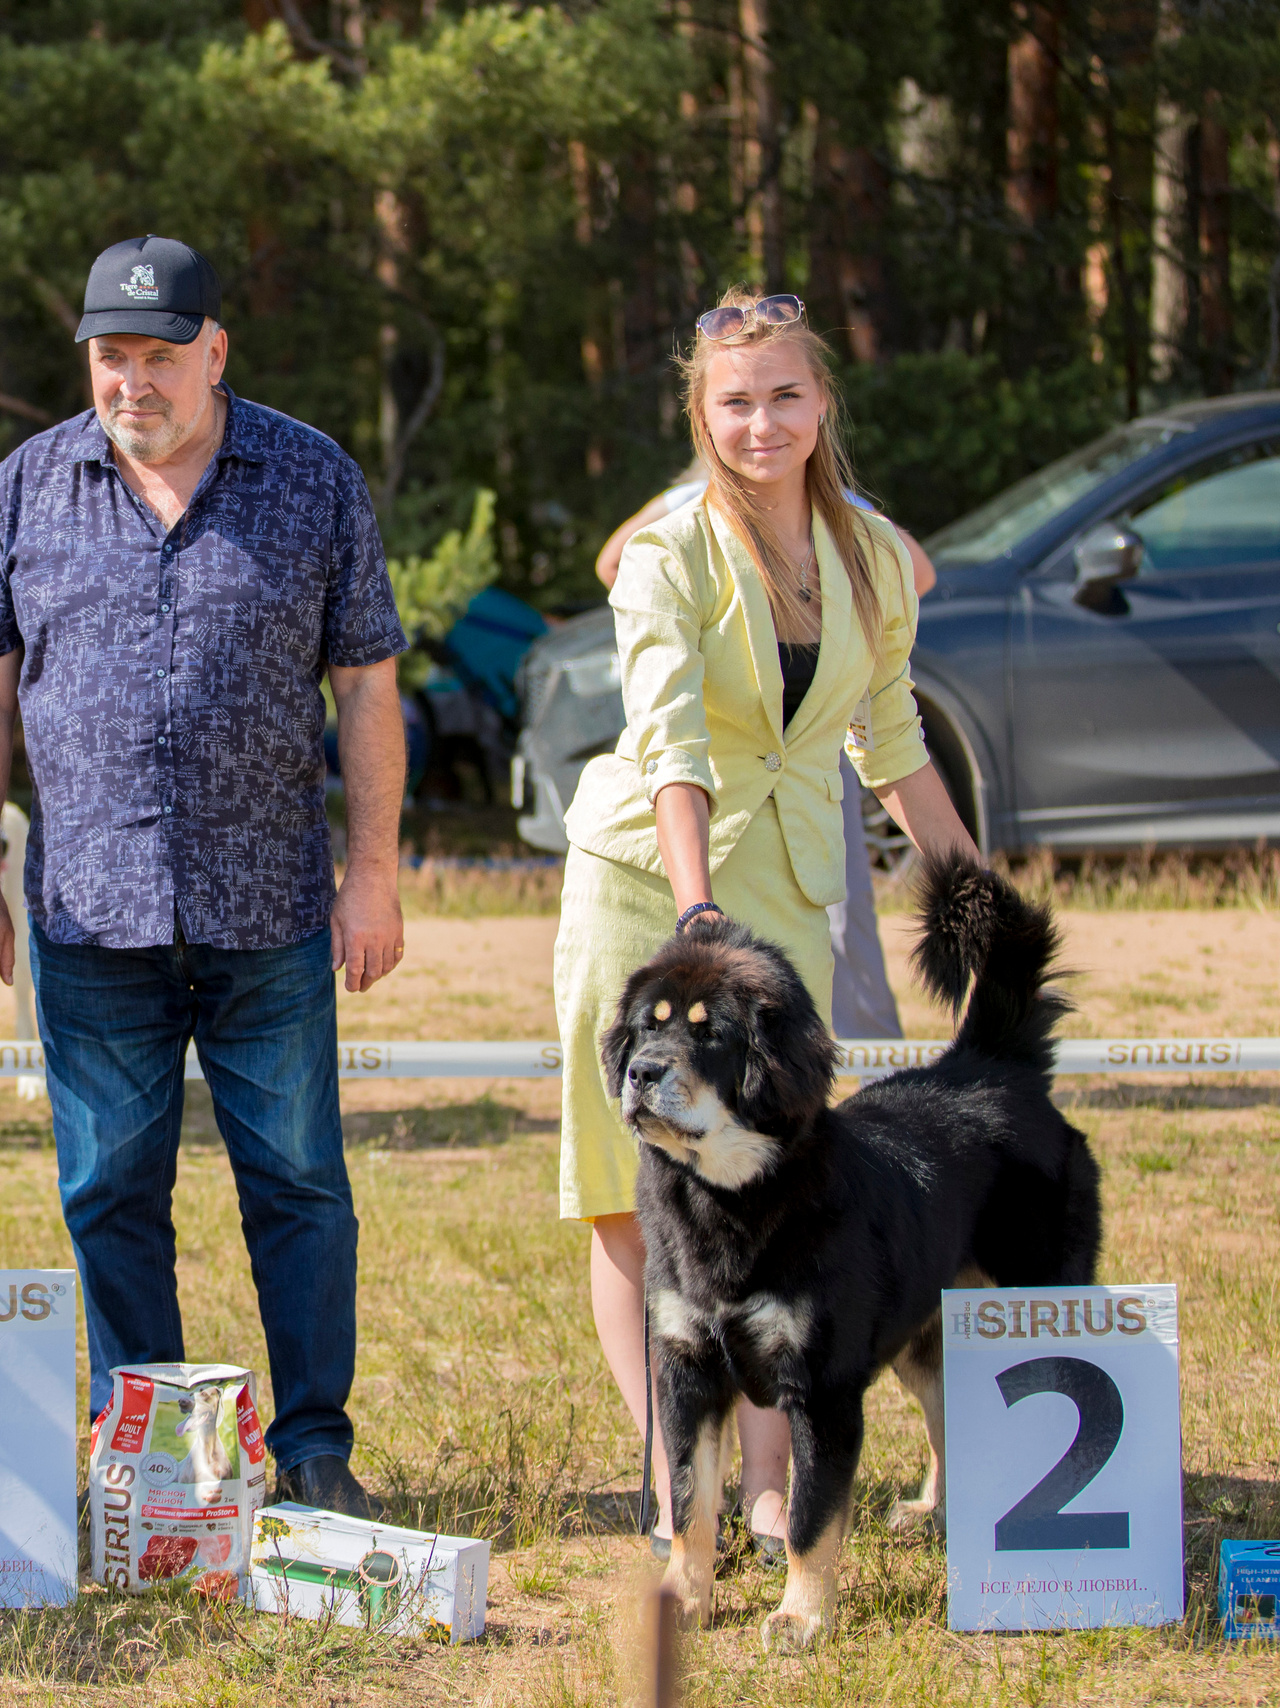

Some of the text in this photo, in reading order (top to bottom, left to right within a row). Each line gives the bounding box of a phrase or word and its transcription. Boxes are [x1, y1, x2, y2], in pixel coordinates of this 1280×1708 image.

[120, 283, 138, 291] Tigre
[1106, 1044, 1231, 1066] SIRIUS
[977, 1297, 1147, 1340] SIRIUS
[119, 1424, 142, 1436] ADULT
[994, 1356, 1131, 1552] 2
[148, 1464, 172, 1474] 40%
[148, 1488, 186, 1498] МЯСНОЙ
[147, 1496, 183, 1505] РАЦИОН
[205, 1508, 235, 1518] ProStor+
[104, 1462, 136, 1588] SIRIUS
[980, 1582, 1011, 1594] ВСЕ
[1015, 1579, 1059, 1595] ДЕЛО
[1064, 1580, 1073, 1592] В
